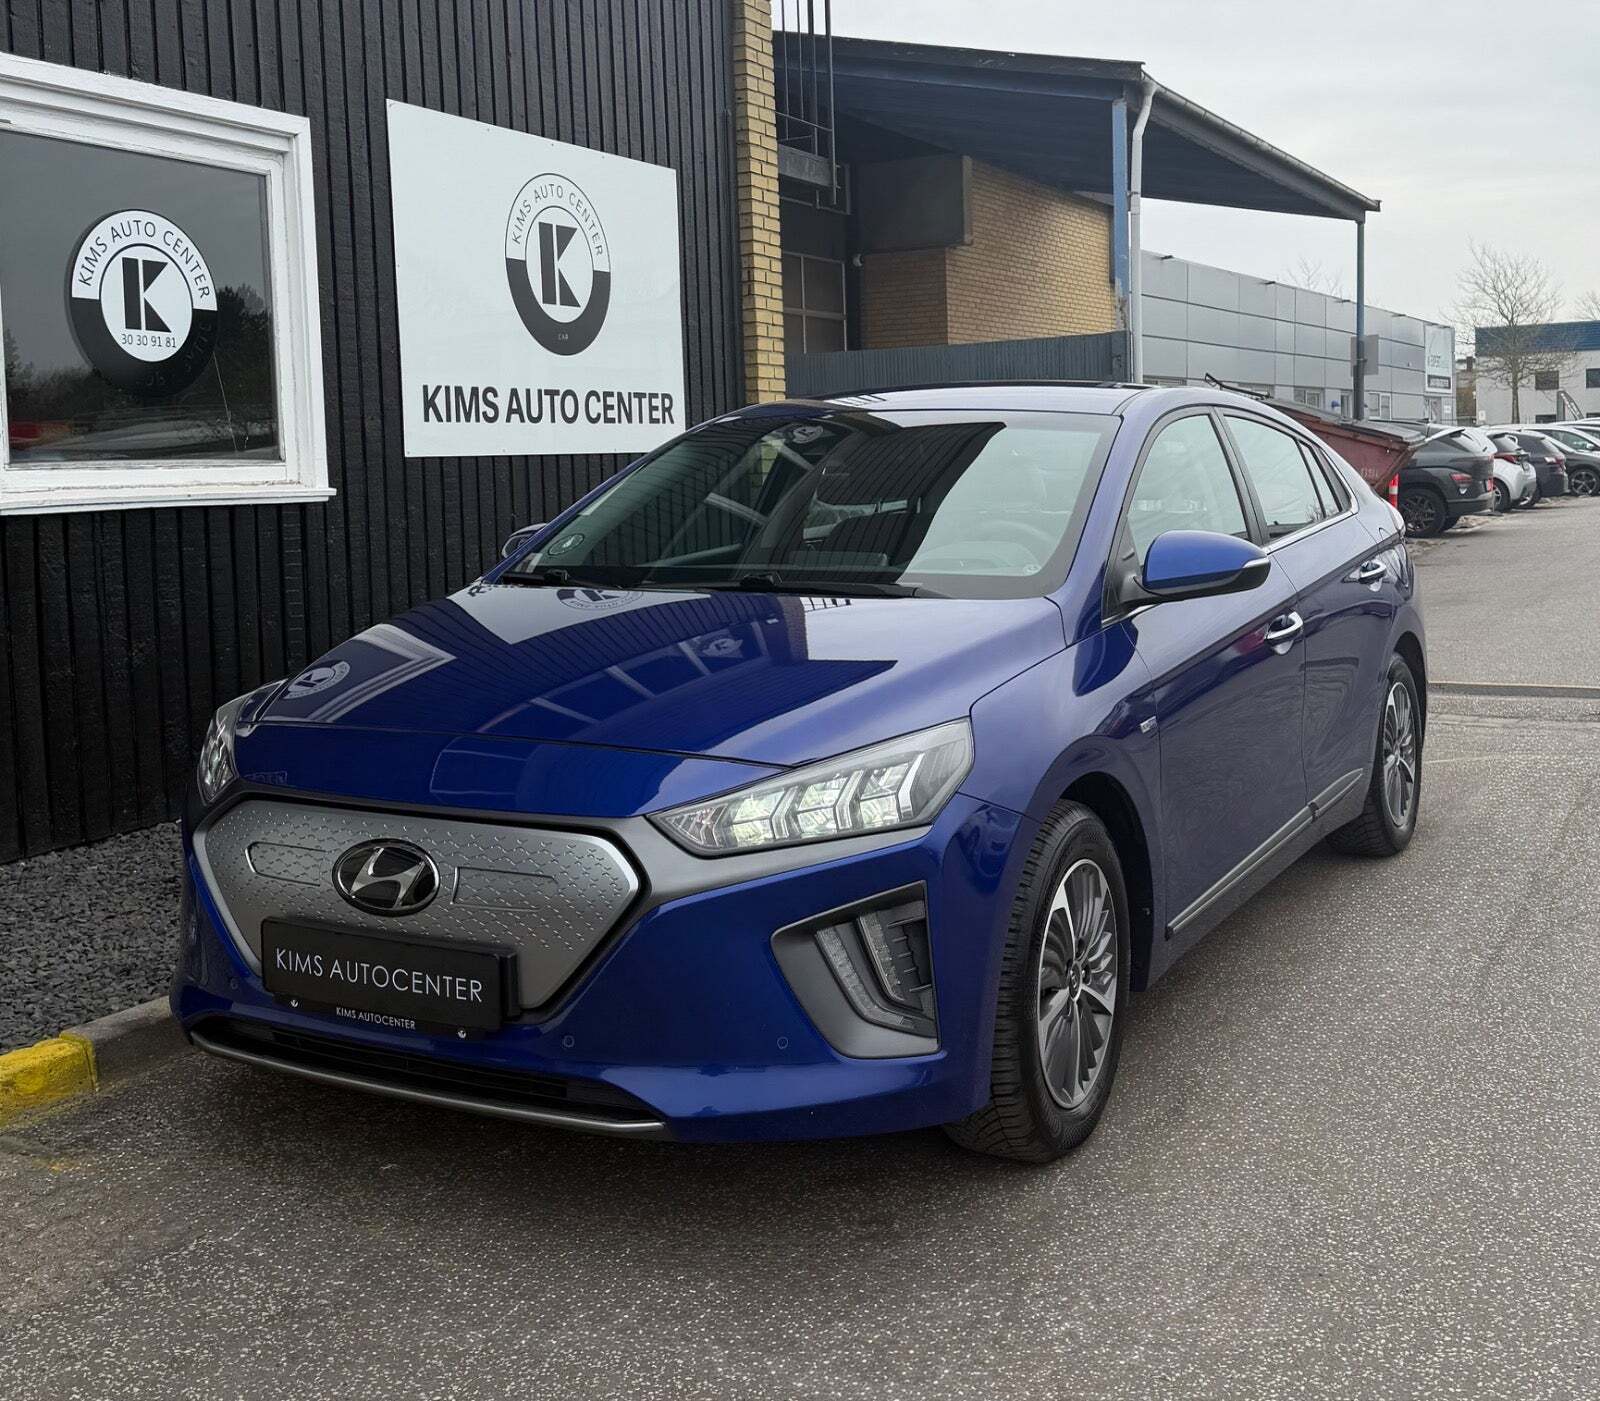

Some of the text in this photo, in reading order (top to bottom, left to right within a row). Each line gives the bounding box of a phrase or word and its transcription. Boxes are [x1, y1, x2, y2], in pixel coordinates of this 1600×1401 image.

[512, 183, 603, 256] KIMS AUTO CENTER
[78, 219, 210, 299] KIMS AUTO CENTER
[121, 333, 177, 348] 30 30 91 81
[422, 384, 676, 425] KIMS AUTO CENTER
[275, 947, 483, 1003] KIMS AUTOCENTER
[335, 1006, 416, 1030] KIMS AUTOCENTER
